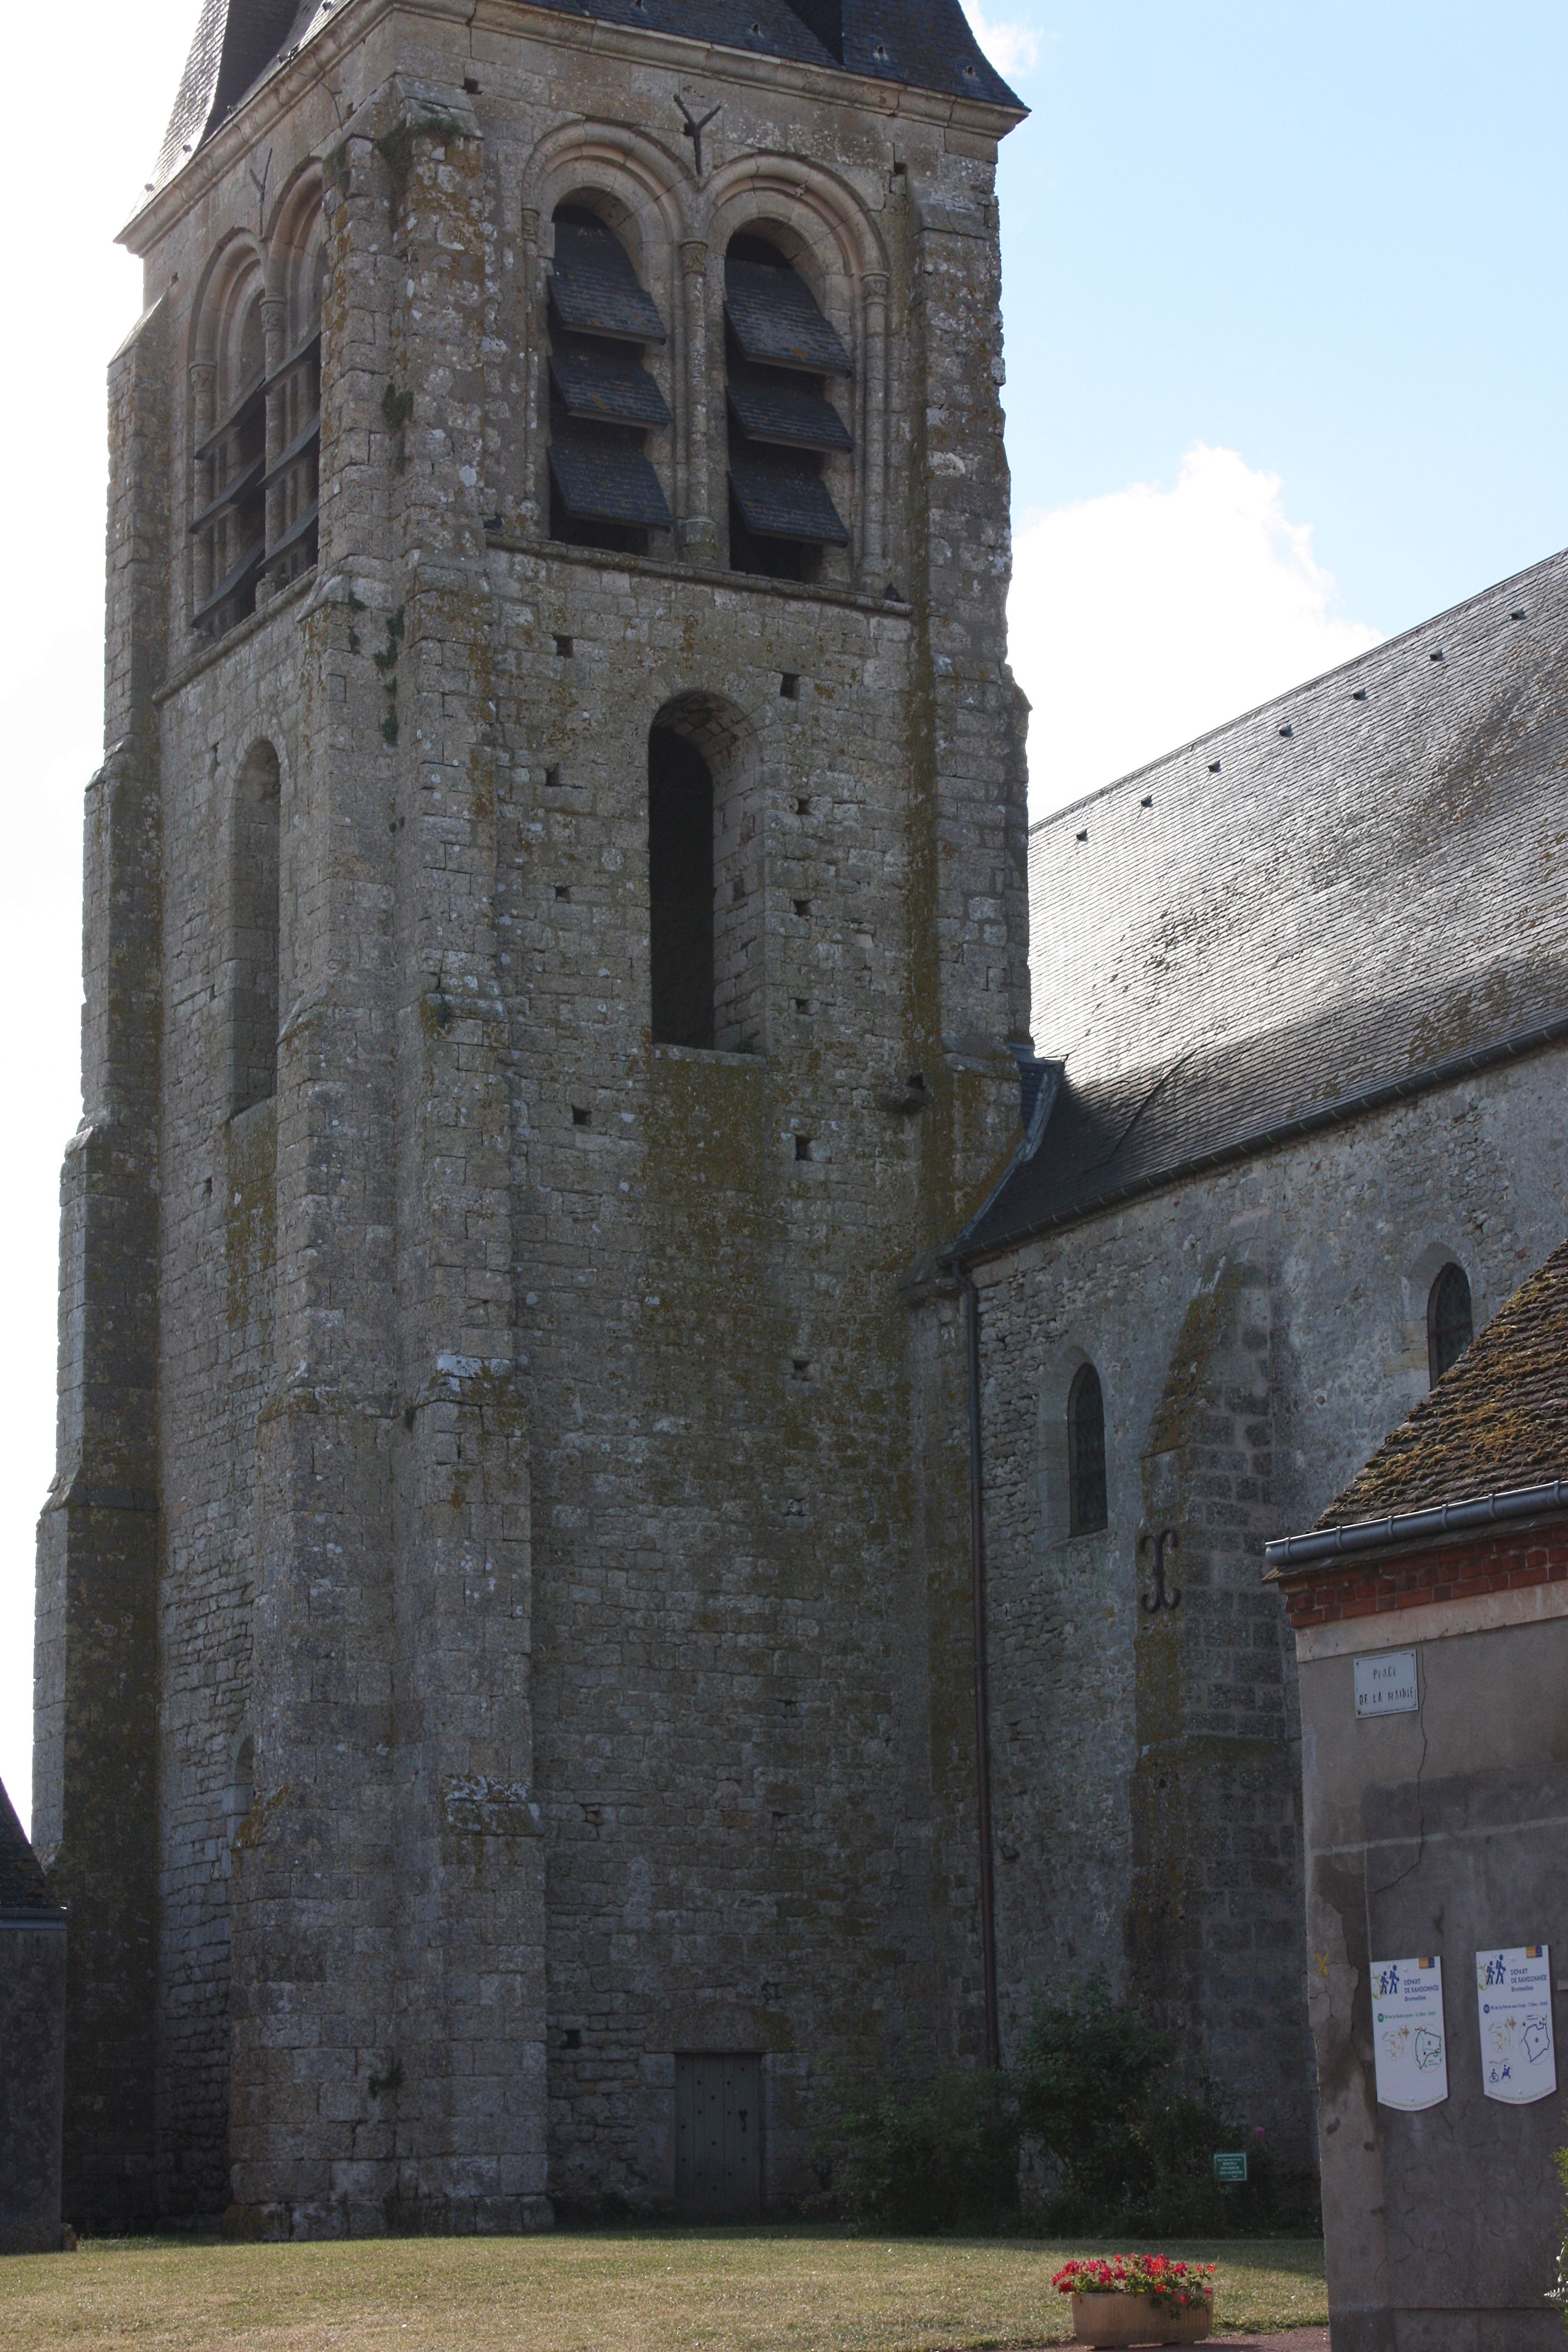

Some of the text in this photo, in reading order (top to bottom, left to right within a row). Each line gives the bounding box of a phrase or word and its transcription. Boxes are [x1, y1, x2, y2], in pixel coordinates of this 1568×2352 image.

[1373, 1666, 1396, 1679] PLACE
[1359, 1687, 1413, 1705] DE LA MAIRIE
[1518, 1974, 1547, 1983] RANDONNÉE
